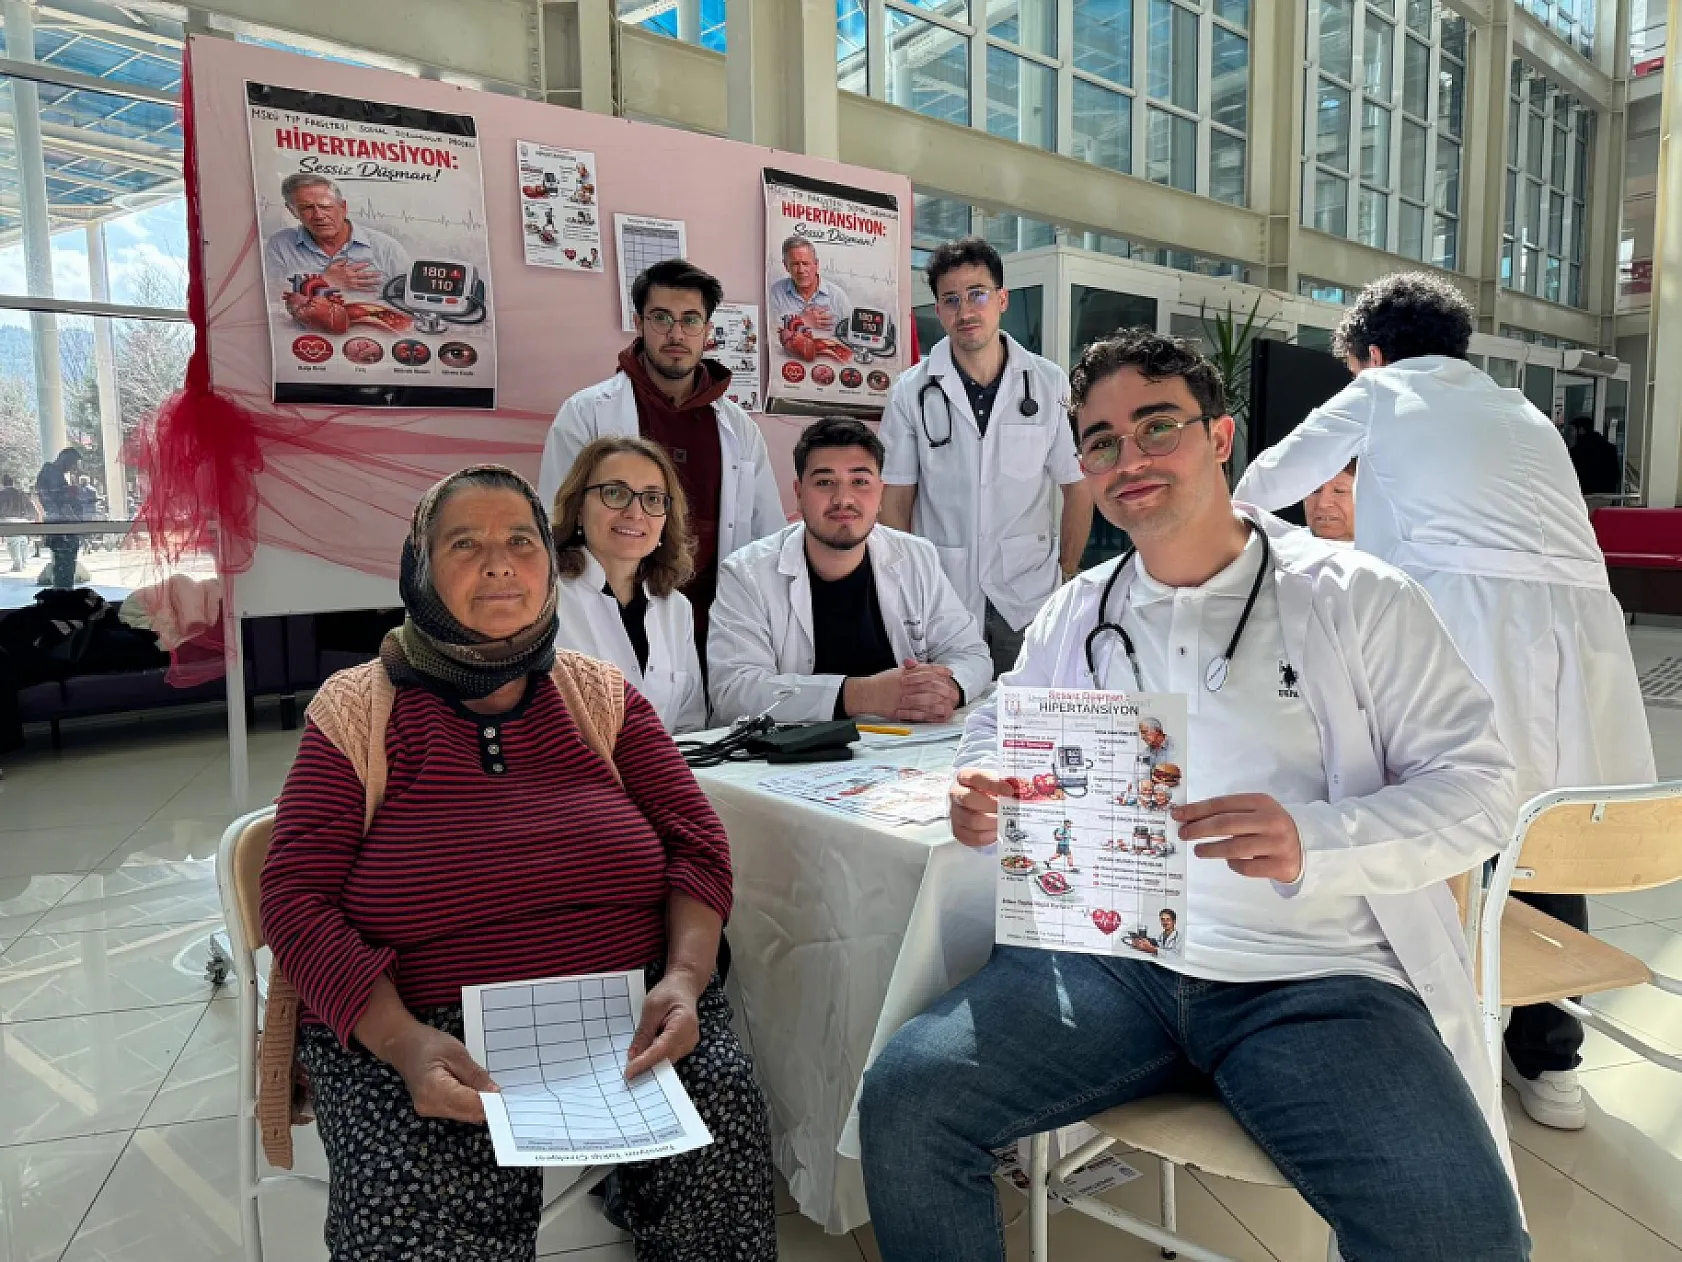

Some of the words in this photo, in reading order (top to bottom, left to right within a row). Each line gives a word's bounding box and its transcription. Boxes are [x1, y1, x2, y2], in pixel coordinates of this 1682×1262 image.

[275, 127, 458, 169] HİPERTANSİYON:
[299, 156, 353, 175] Sessiz
[357, 162, 441, 182] Düşman!
[781, 201, 887, 237] HİPERTANSİYON:
[423, 266, 446, 279] 180
[430, 280, 454, 292] 110
